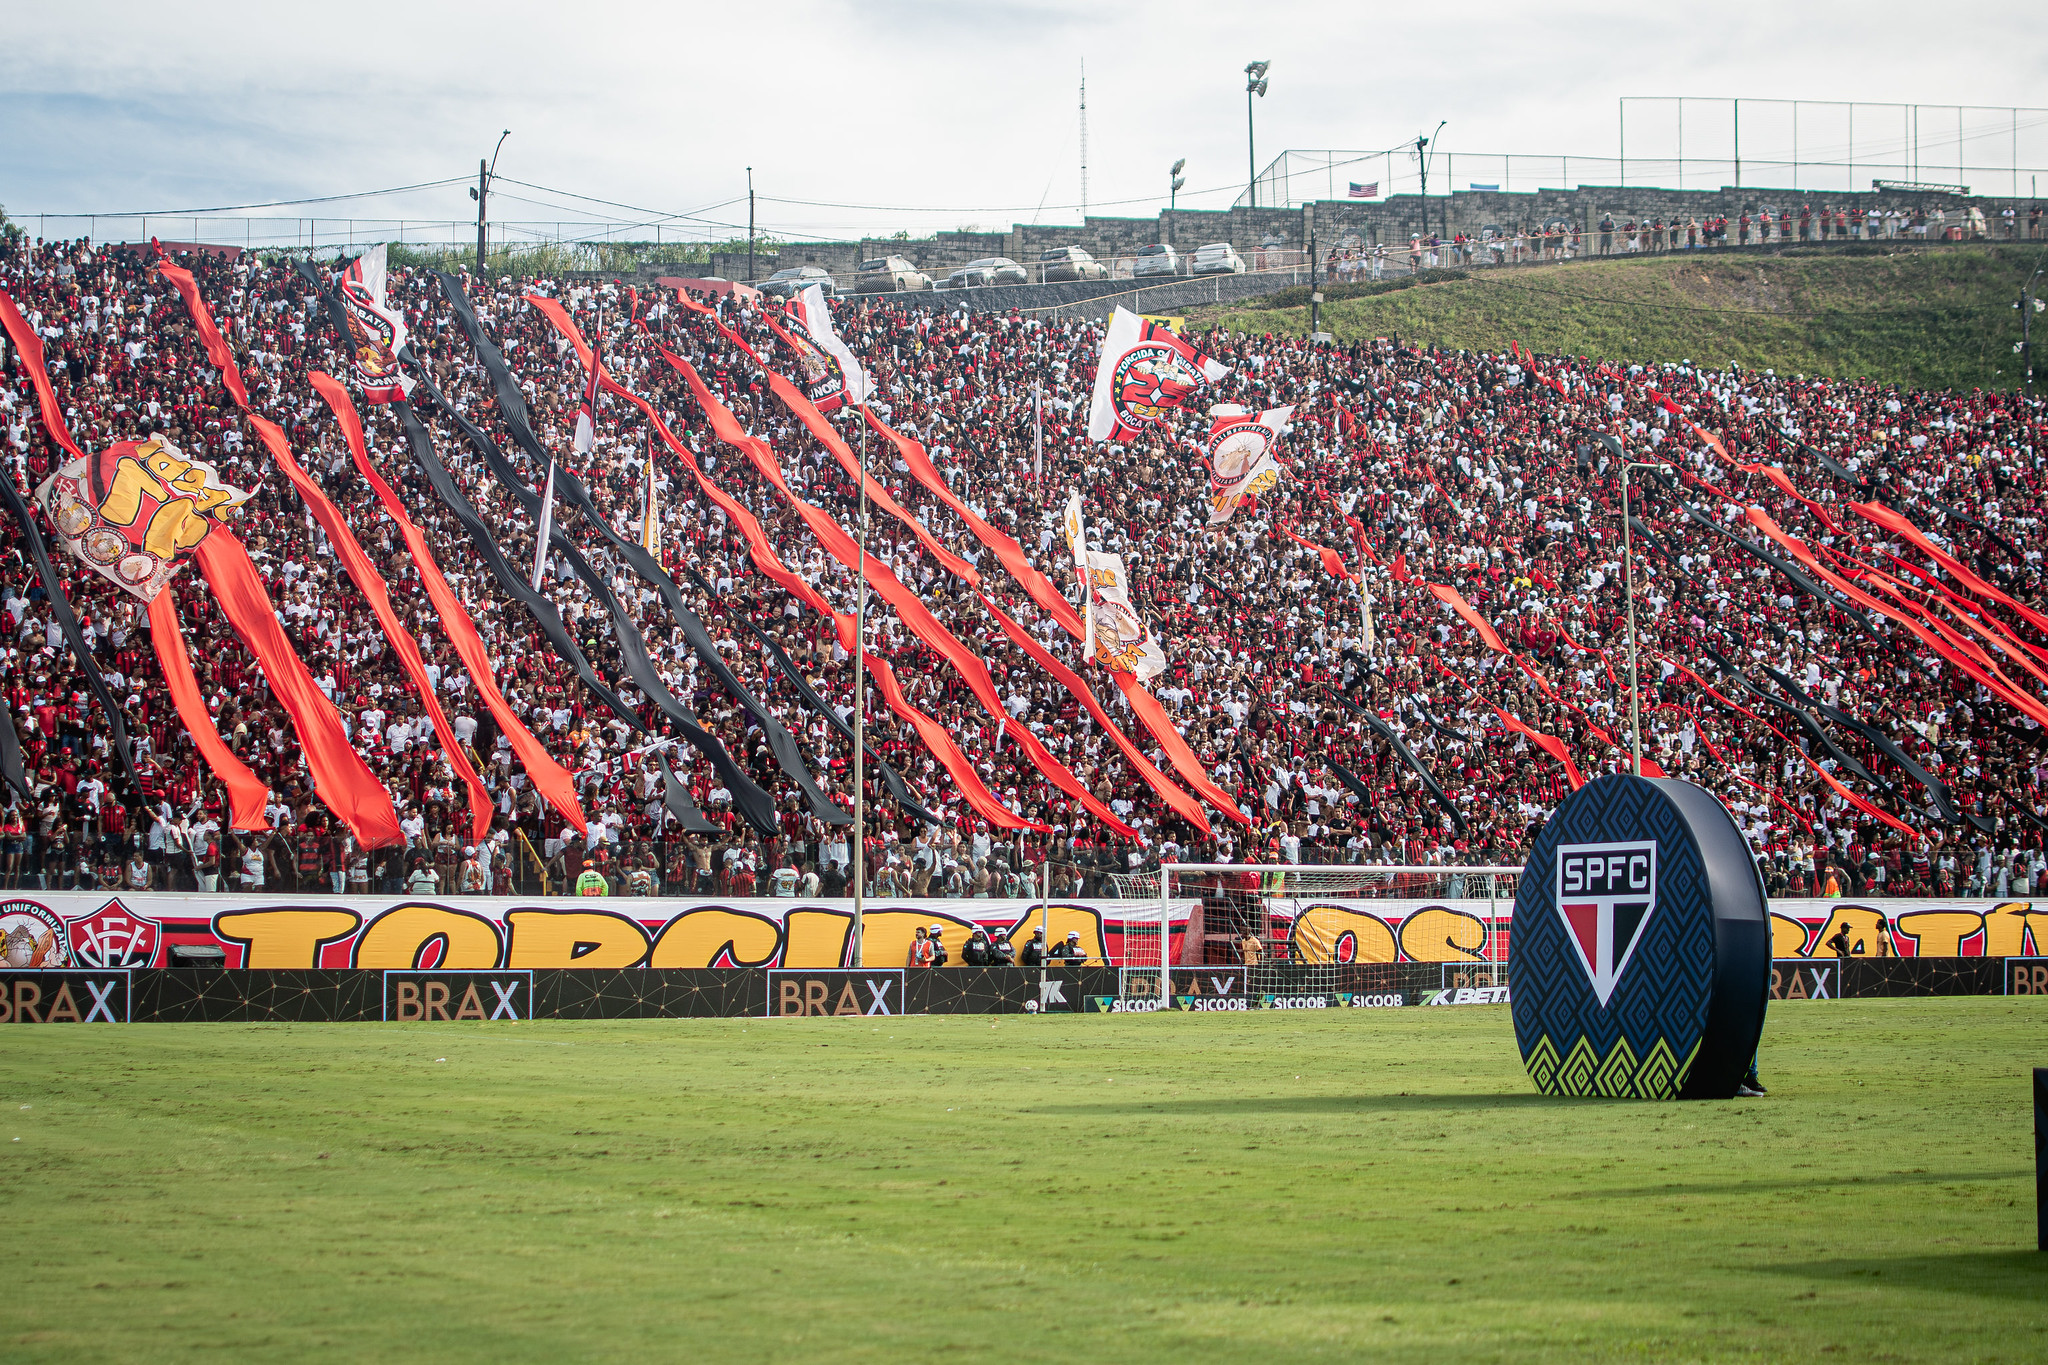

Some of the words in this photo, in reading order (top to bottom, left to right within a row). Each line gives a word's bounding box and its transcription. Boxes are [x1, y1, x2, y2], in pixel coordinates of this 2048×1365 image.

[1116, 348, 1155, 375] TORCIDA
[1119, 408, 1144, 428] BOCA
[1564, 854, 1648, 891] SPFC
[1769, 967, 1832, 1000] RAX
[397, 981, 519, 1021] BRAX
[779, 979, 893, 1016] BRAX
[1194, 998, 1248, 1012] SICOOB
[1274, 995, 1327, 1010] SICOOB
[1352, 994, 1403, 1009] SICOOB
